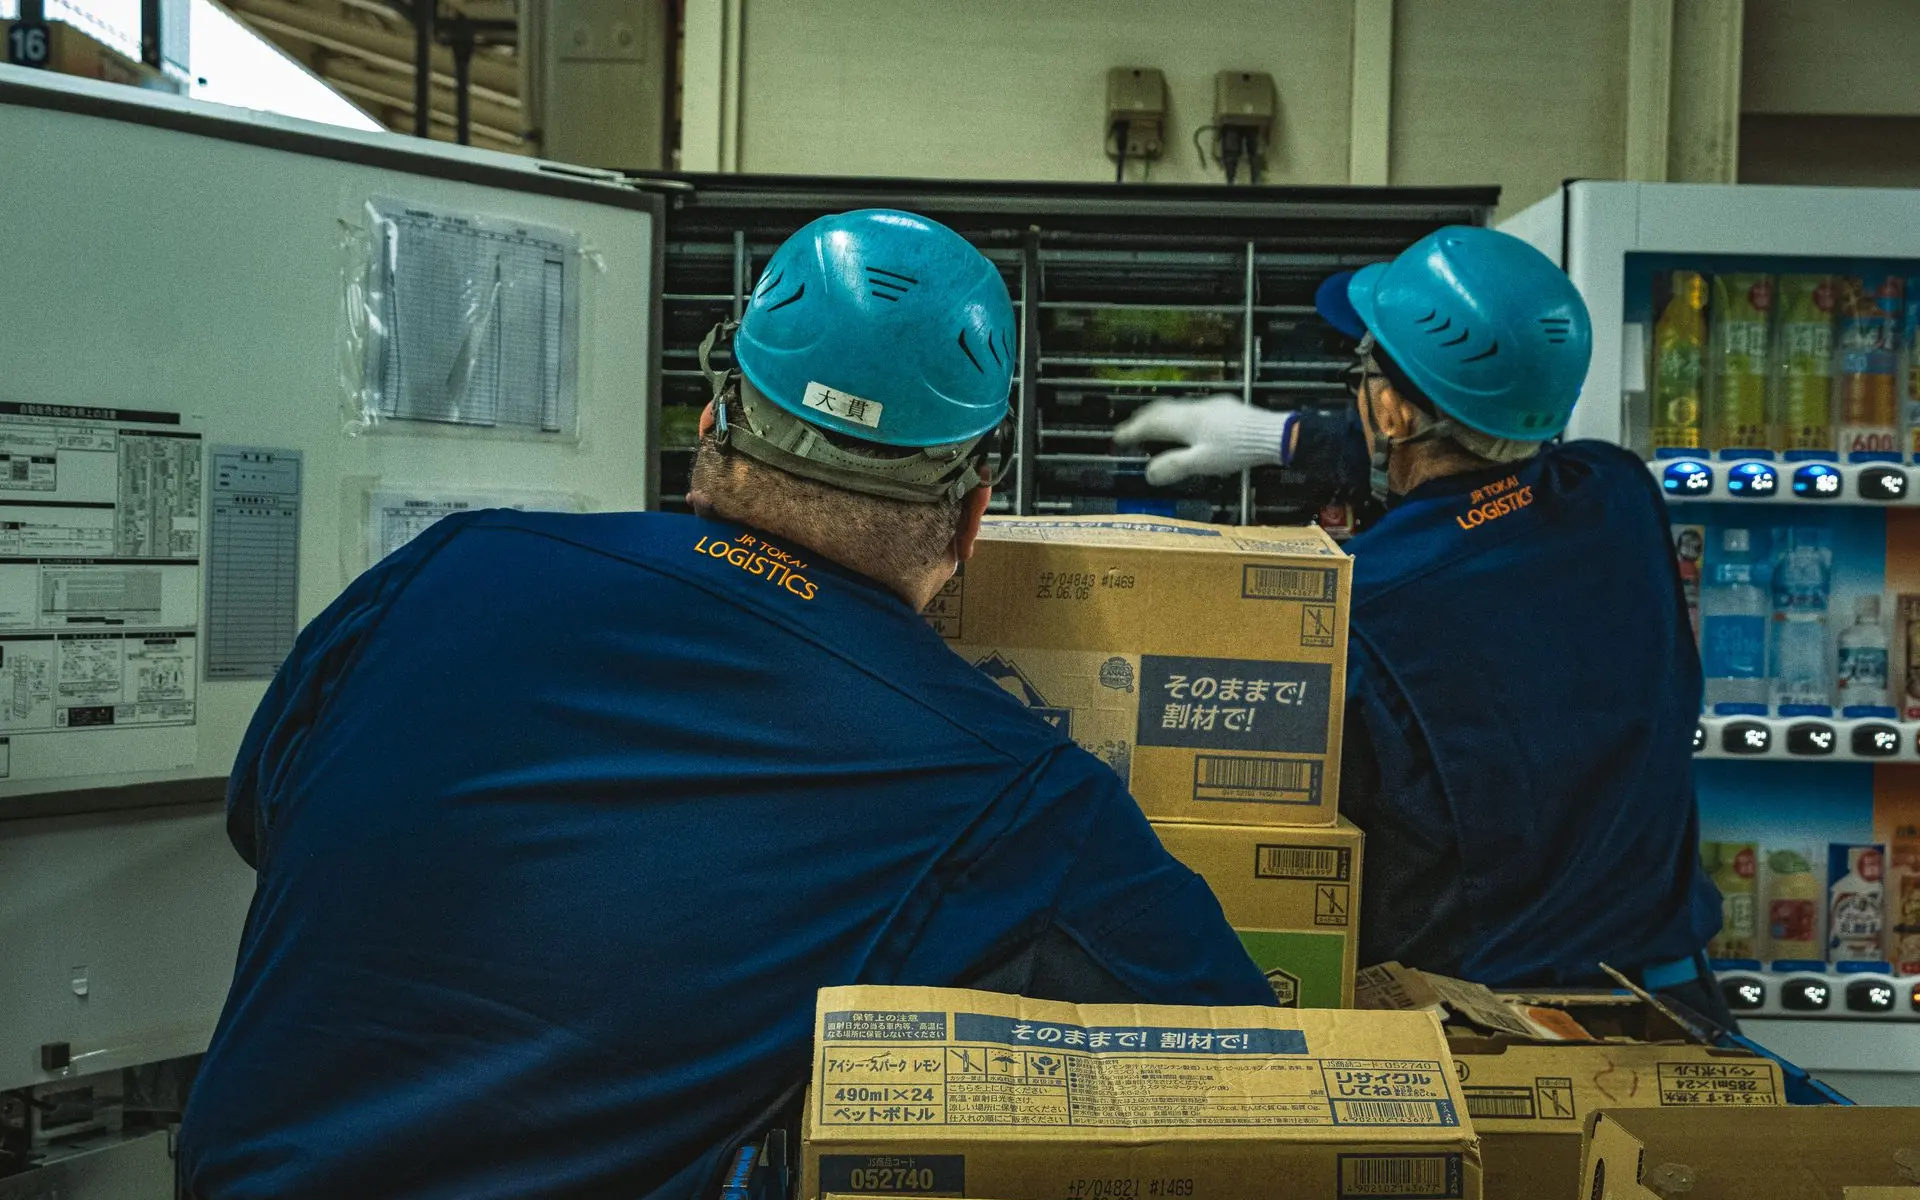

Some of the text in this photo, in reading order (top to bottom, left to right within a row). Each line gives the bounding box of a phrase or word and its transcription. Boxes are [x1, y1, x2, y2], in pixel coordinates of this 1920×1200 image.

[10, 27, 46, 61] 16
[734, 534, 808, 569] JR TOKAI
[693, 535, 819, 600] LOGISTICS
[1164, 674, 1306, 705] そのままで!
[1161, 702, 1256, 732] 割材で!
[852, 1013, 919, 1023] 保管上の注意
[1011, 1024, 1249, 1050] そのままで! 割材で!
[914, 1059, 942, 1073] レモン
[1674, 1065, 1757, 1077] ペットボトル
[1335, 1071, 1432, 1085] リサイクル
[1676, 1079, 1757, 1092] 285ml×24
[835, 1087, 935, 1102] 490ml×24
[948, 1084, 1048, 1095] こちらを上にしてください
[1338, 1084, 1393, 1097] してね
[1664, 1092, 1700, 1104] 天然水
[833, 1106, 936, 1122] ペットボトル
[850, 1168, 934, 1191] 052740
[1149, 1179, 1194, 1197] #1469
